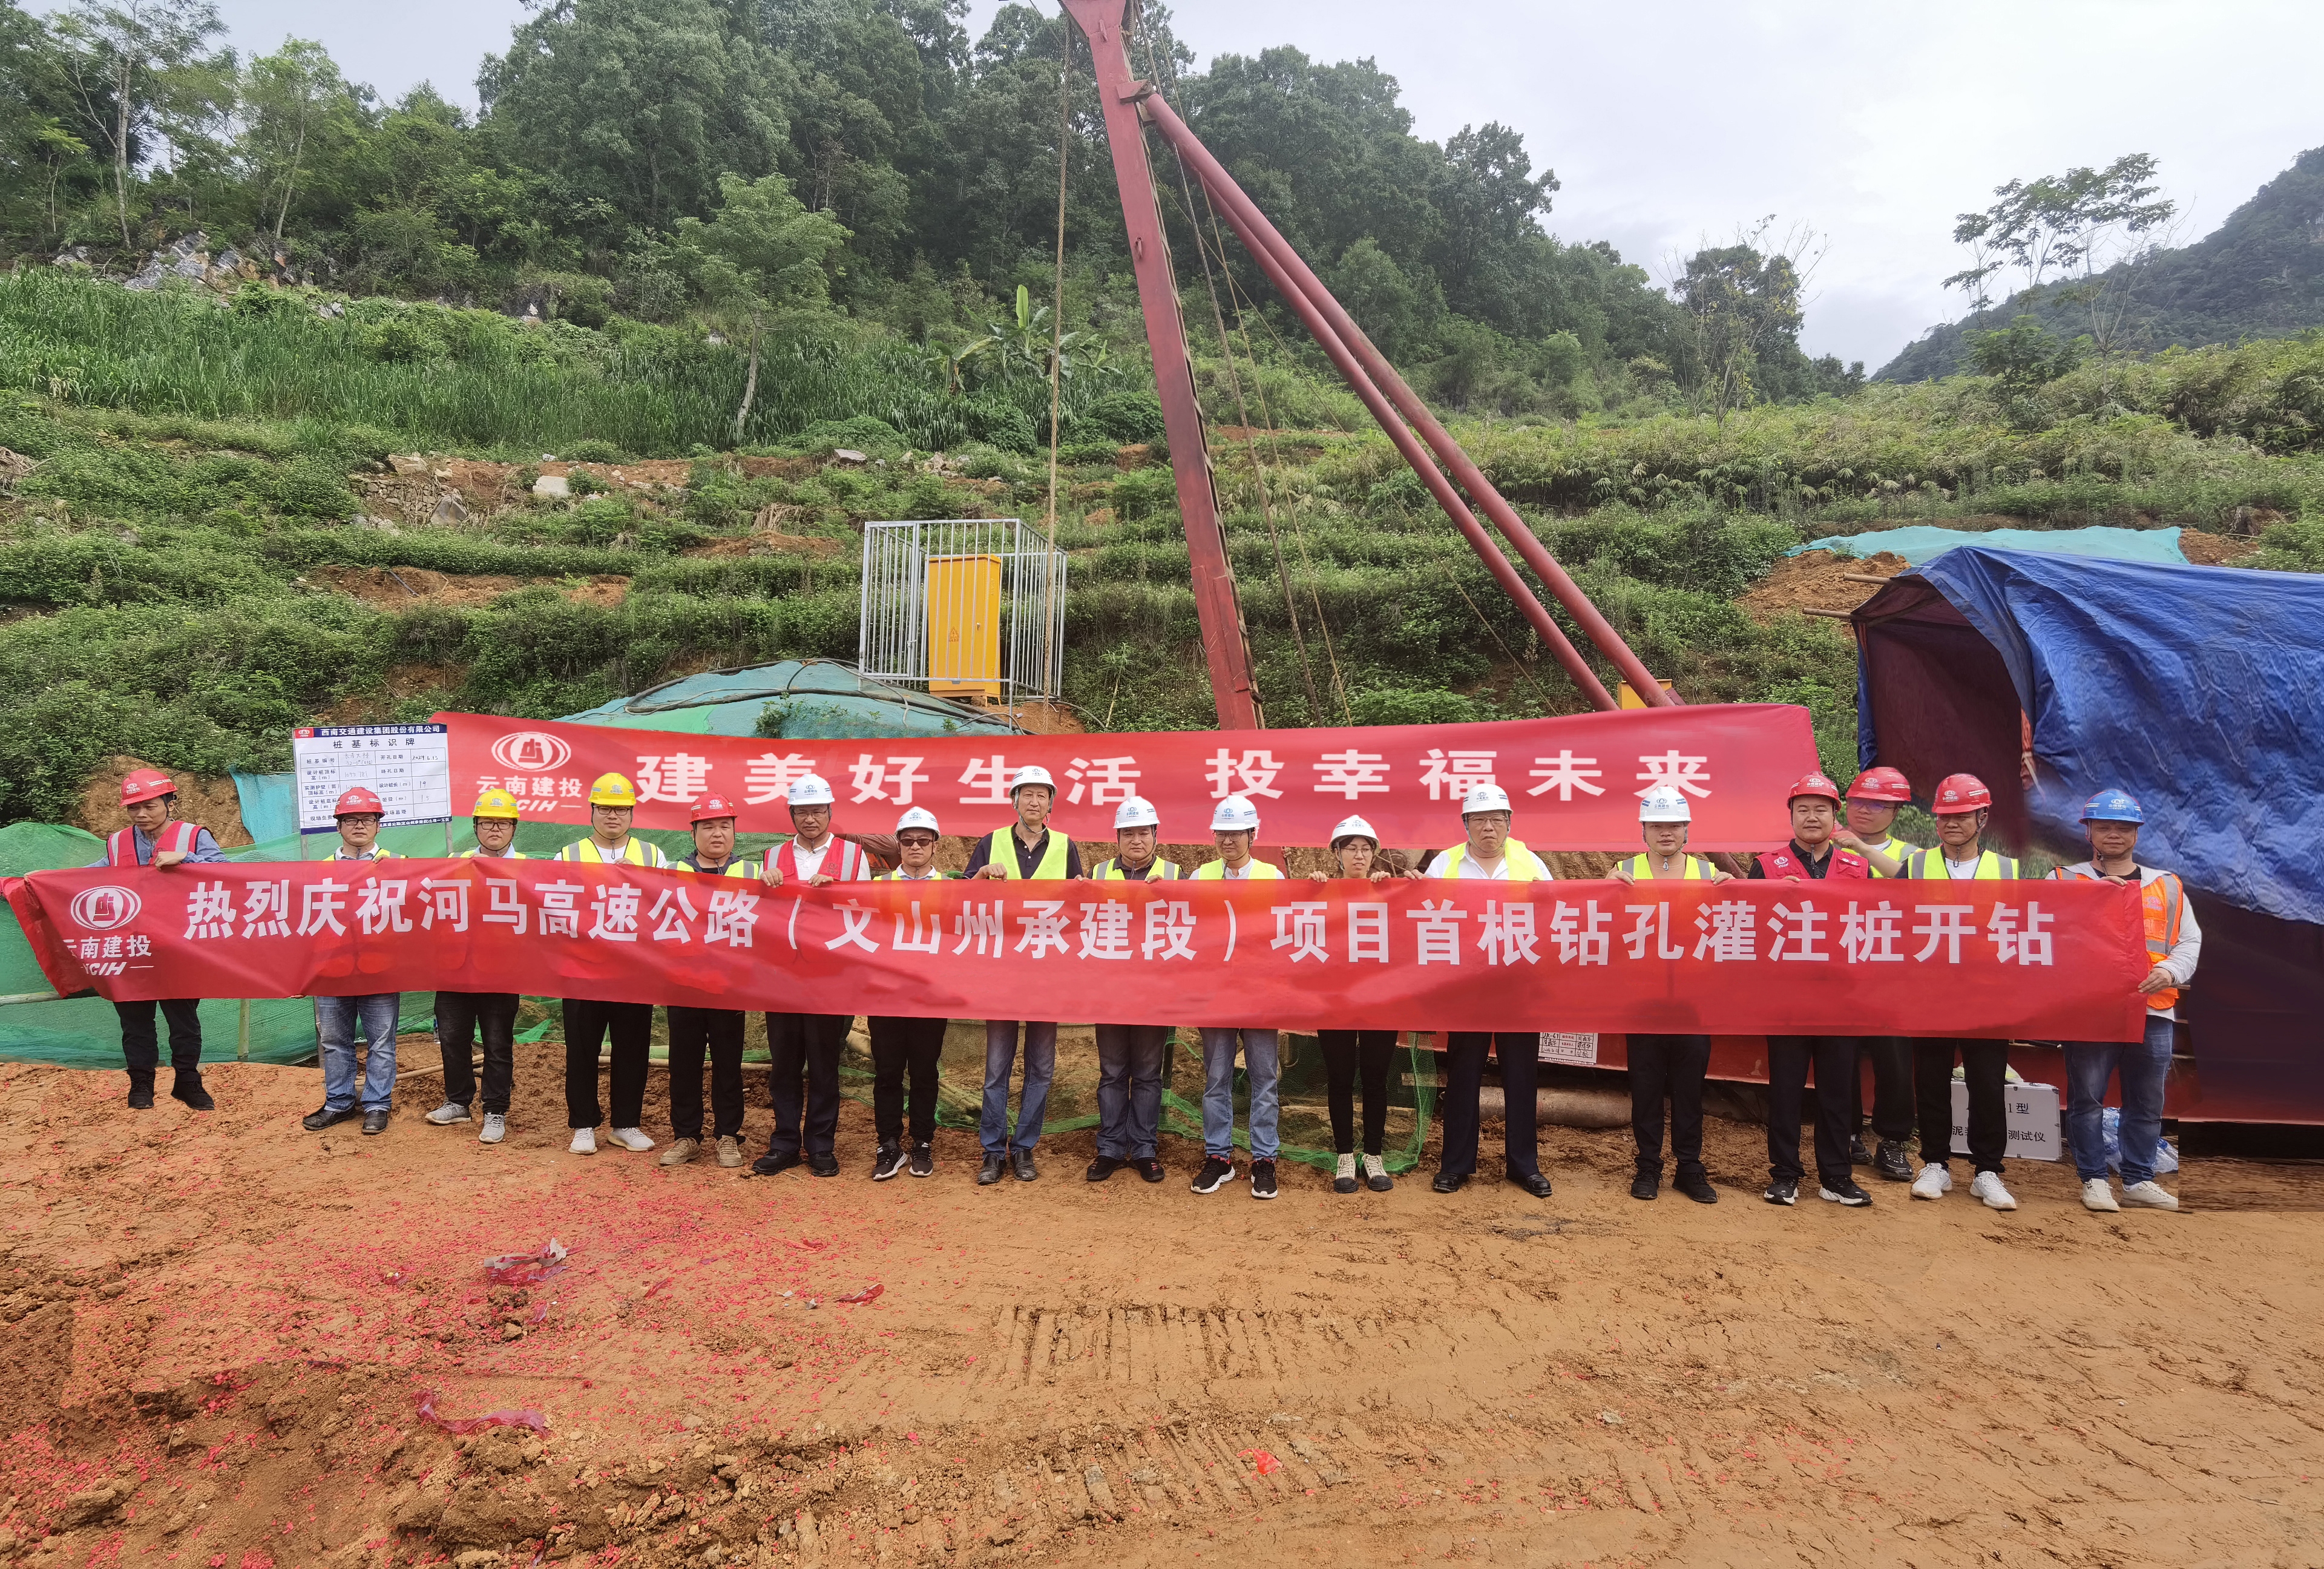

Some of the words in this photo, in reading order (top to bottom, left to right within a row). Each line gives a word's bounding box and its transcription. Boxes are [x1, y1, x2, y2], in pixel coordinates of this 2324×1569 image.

[320, 725, 439, 735] 西南交通建设集团股份有限公司
[333, 738, 415, 748] 桩基标识牌
[636, 752, 1142, 806] 建美好生活
[1205, 748, 1713, 801] 投幸福未来
[476, 775, 582, 797] 云南建投
[514, 799, 558, 812] CIH
[183, 876, 2054, 966] 热烈庆祝河马高速公路（文山州承建段）项目首根钻孔灌注桩开钻
[2008, 1130, 2046, 1142] 测试仪
